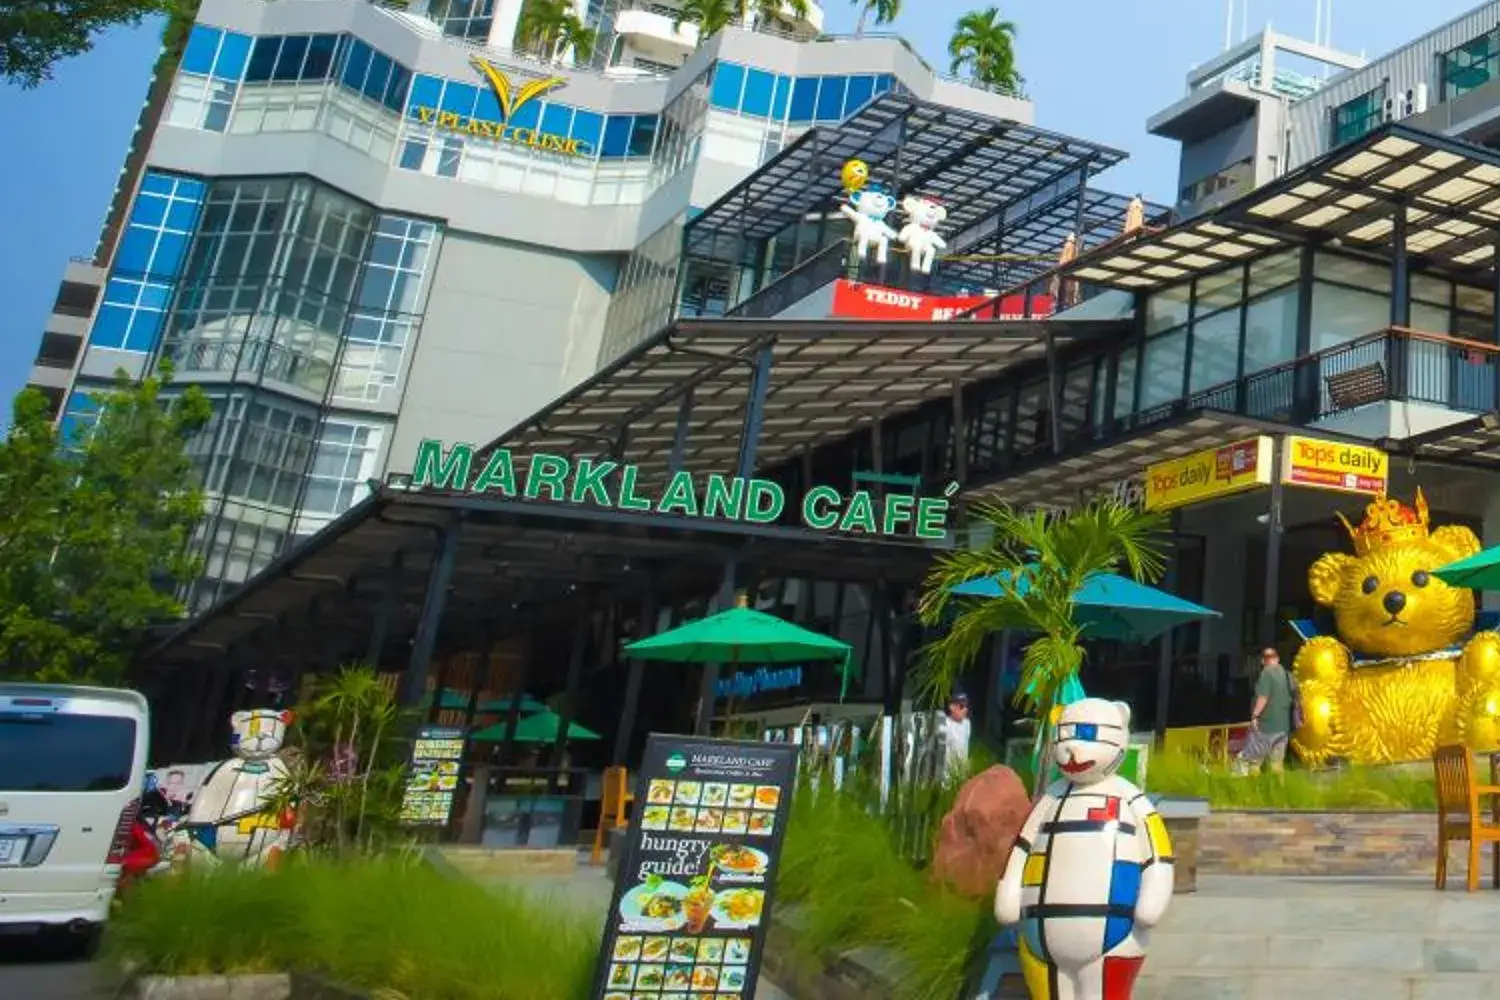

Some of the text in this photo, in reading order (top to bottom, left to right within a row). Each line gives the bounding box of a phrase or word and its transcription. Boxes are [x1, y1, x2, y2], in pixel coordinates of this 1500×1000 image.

[437, 111, 508, 138] PLAST
[512, 126, 588, 157] CLINIC
[865, 289, 923, 310] TEDDY
[1297, 441, 1382, 473] Tops daily
[411, 437, 960, 538] MARKLAND CAFÉ
[1152, 471, 1178, 496] Tops
[1179, 459, 1212, 486] daily
[640, 832, 712, 861] hungry
[637, 857, 700, 880] guide!
